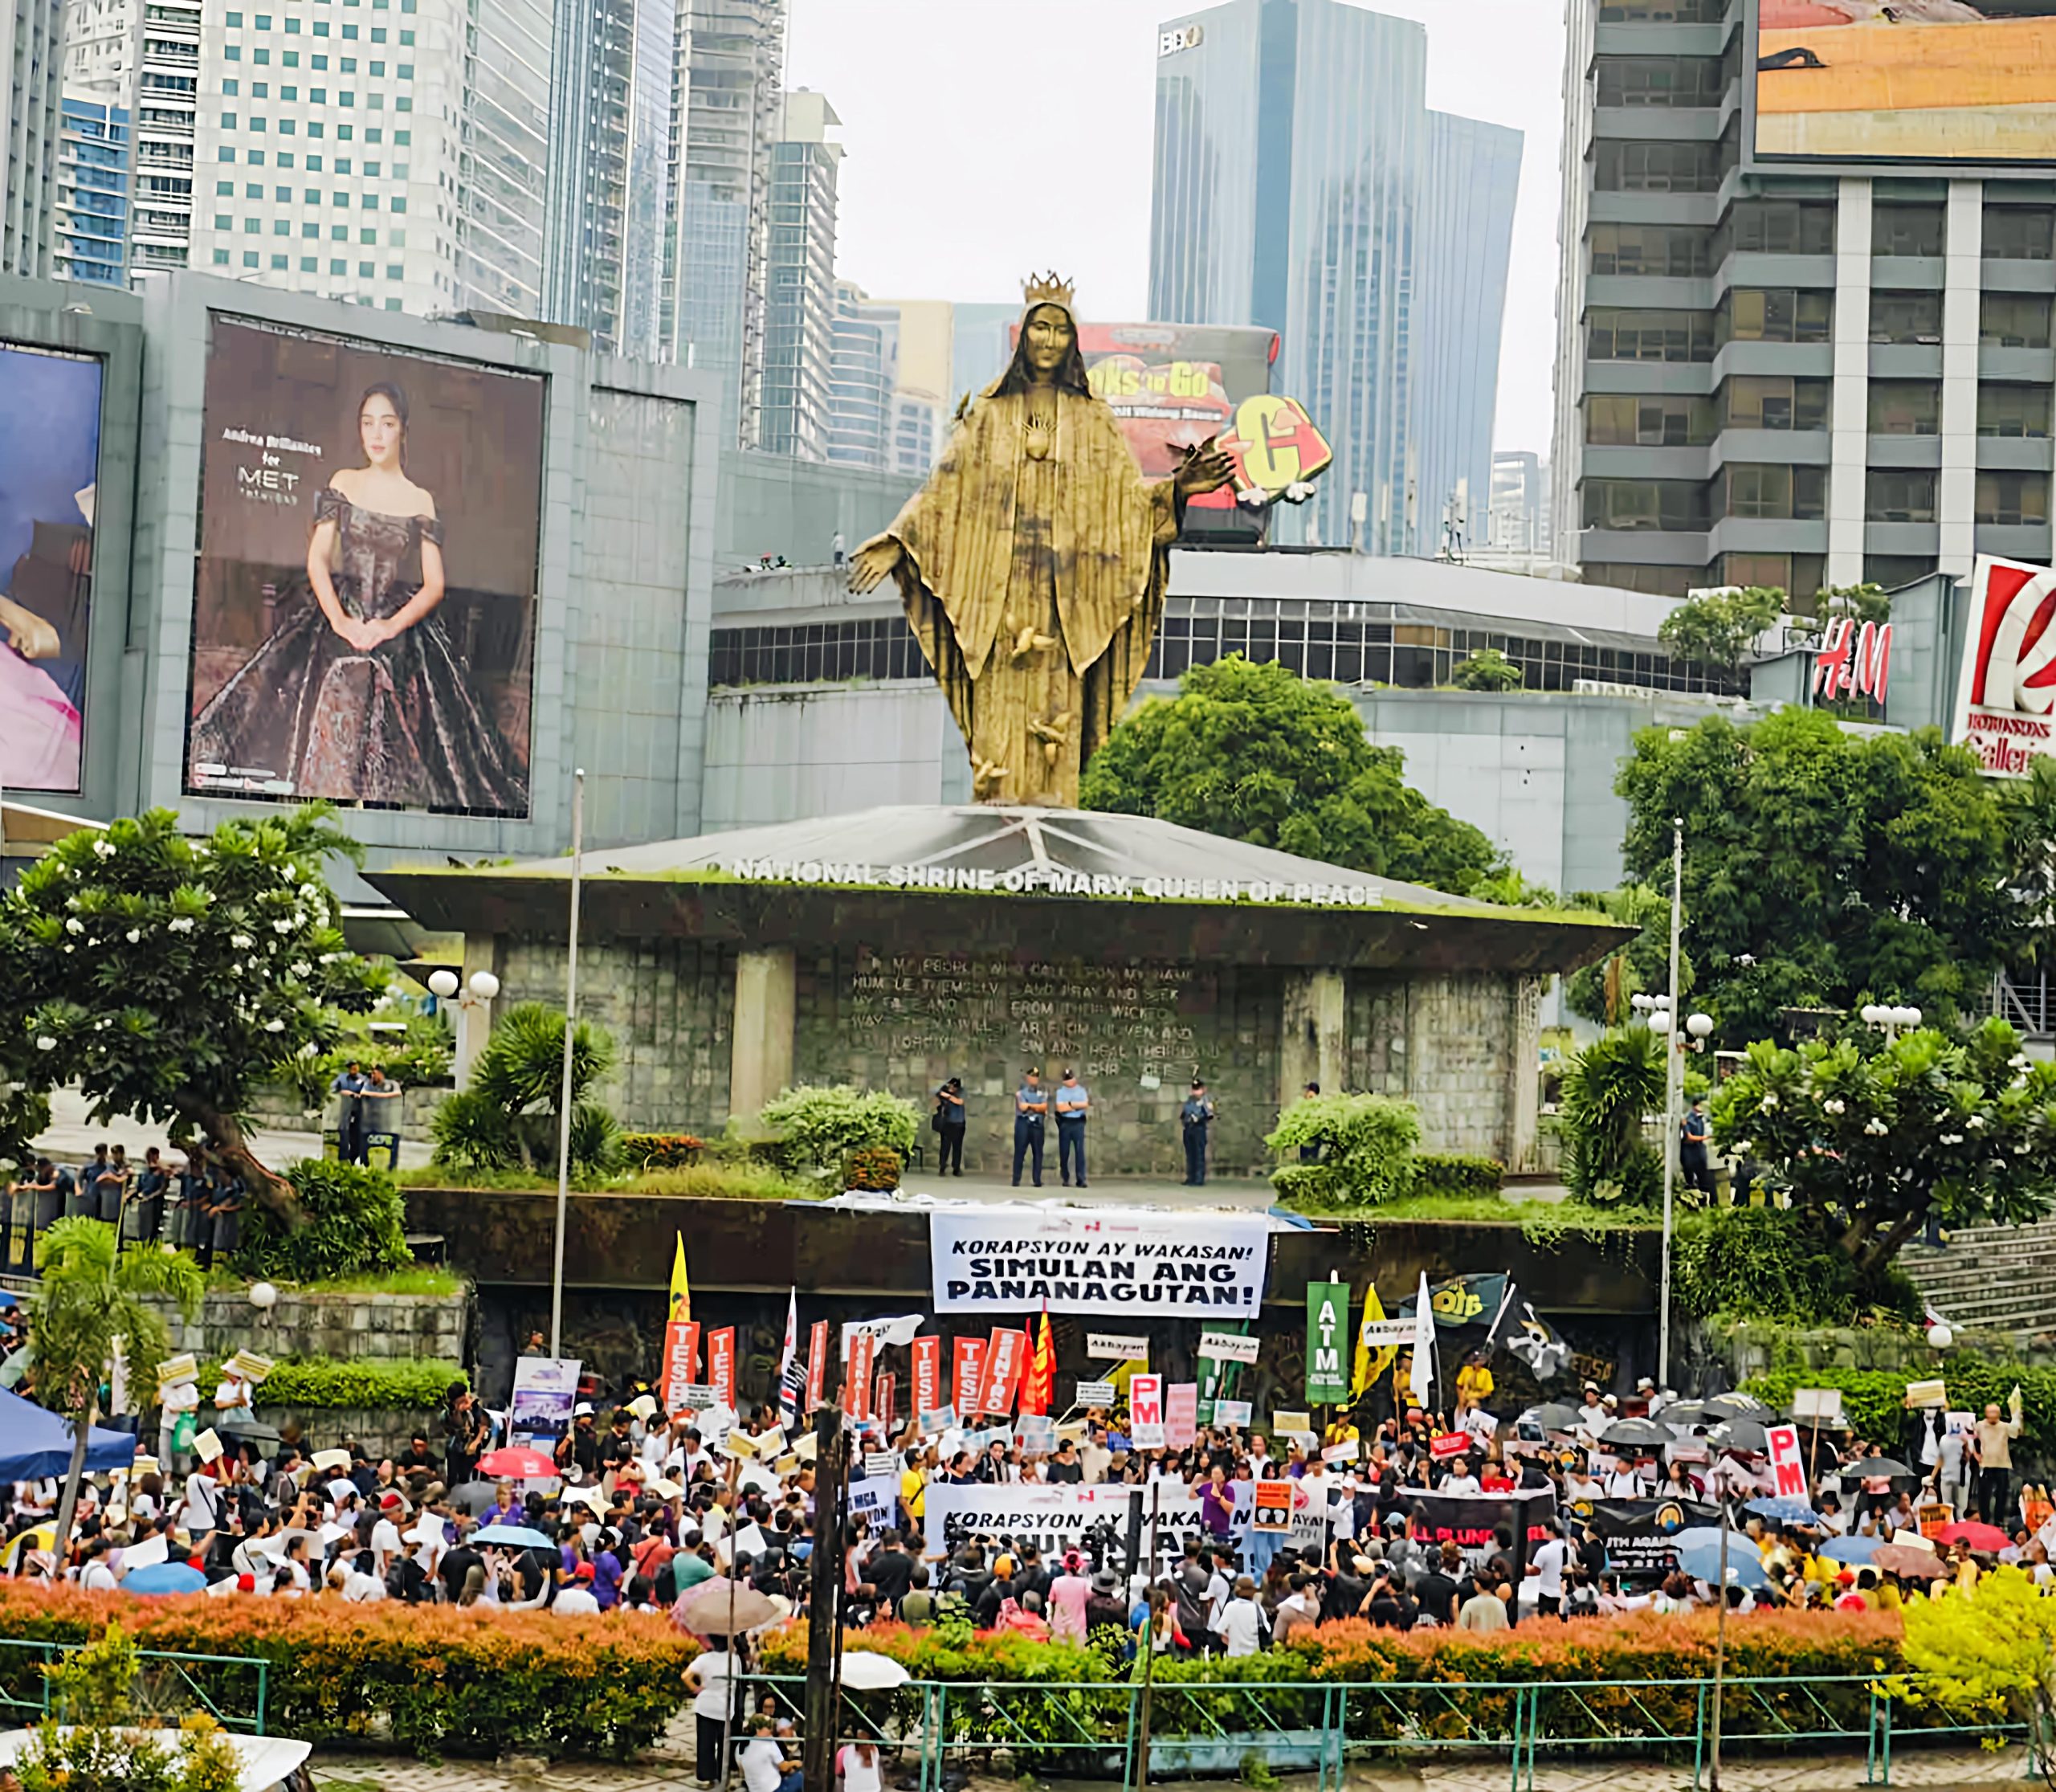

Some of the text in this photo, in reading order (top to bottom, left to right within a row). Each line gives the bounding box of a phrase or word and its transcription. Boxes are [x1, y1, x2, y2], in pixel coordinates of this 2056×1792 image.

[239, 466, 299, 491] MET
[1813, 616, 1892, 705] H&M
[732, 859, 1383, 907] NATIONAL SHRINE OF MARY, QUEEN OF PEACE
[1011, 1001, 1054, 1015] FROM
[952, 1239, 1254, 1260] KORAPSYON AY WAKASAN!
[969, 1258, 1237, 1283] SIMULAN ANG
[947, 1280, 1254, 1306] PANANAGUTAN!
[1315, 1299, 1339, 1370] ATM
[1133, 1378, 1161, 1425] PM
[1769, 1429, 1805, 1496] PM
